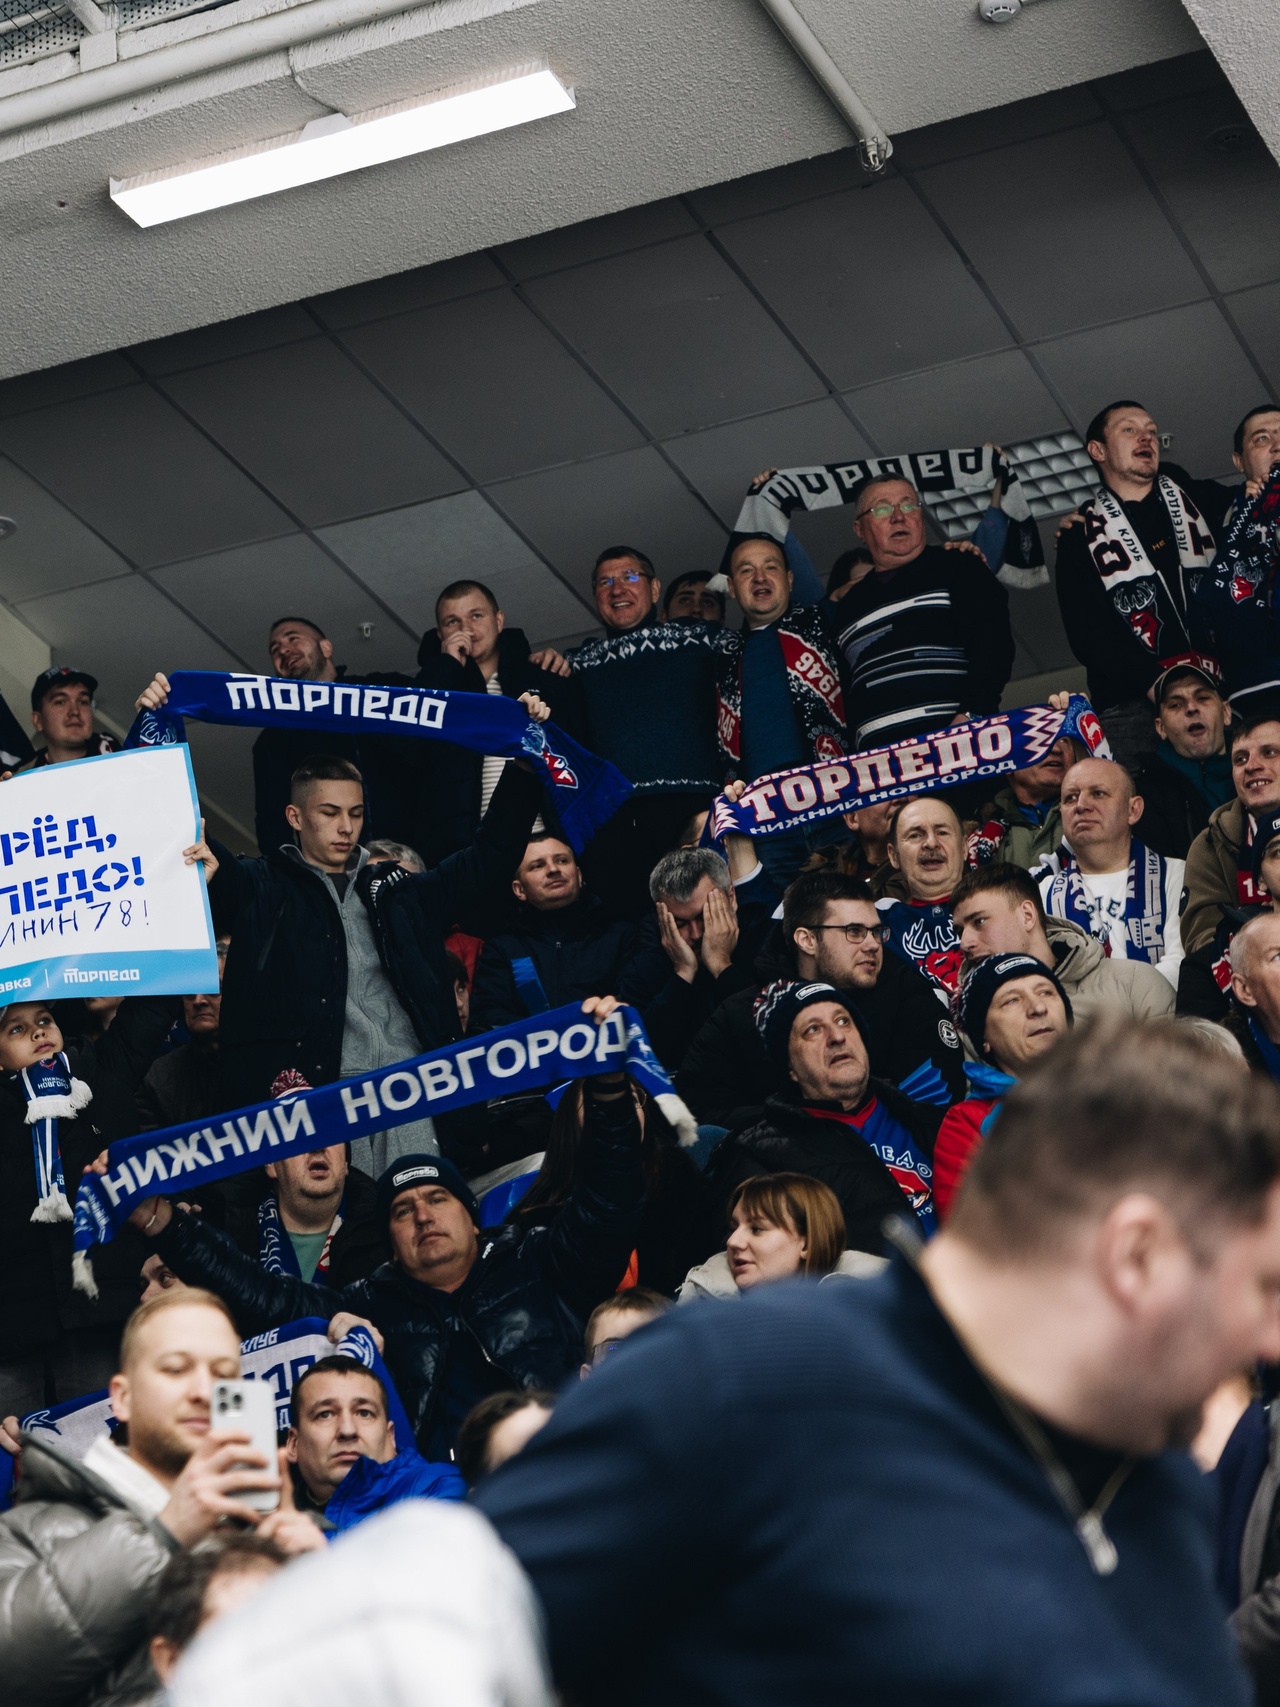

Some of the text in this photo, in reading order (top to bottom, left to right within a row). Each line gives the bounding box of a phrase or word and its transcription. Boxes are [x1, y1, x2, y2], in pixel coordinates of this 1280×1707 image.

[1118, 528, 1143, 562] КЛУБ
[795, 652, 842, 703] 1946
[935, 715, 1010, 740] КЛУБ
[739, 724, 1013, 824] ТОРПЕДО
[750, 759, 1018, 835] НИЖНИЙ НОВГОРОД
[101, 1011, 627, 1201] НИЖНИЙ НОВГОРОД
[240, 1328, 280, 1354] КЛУБ
